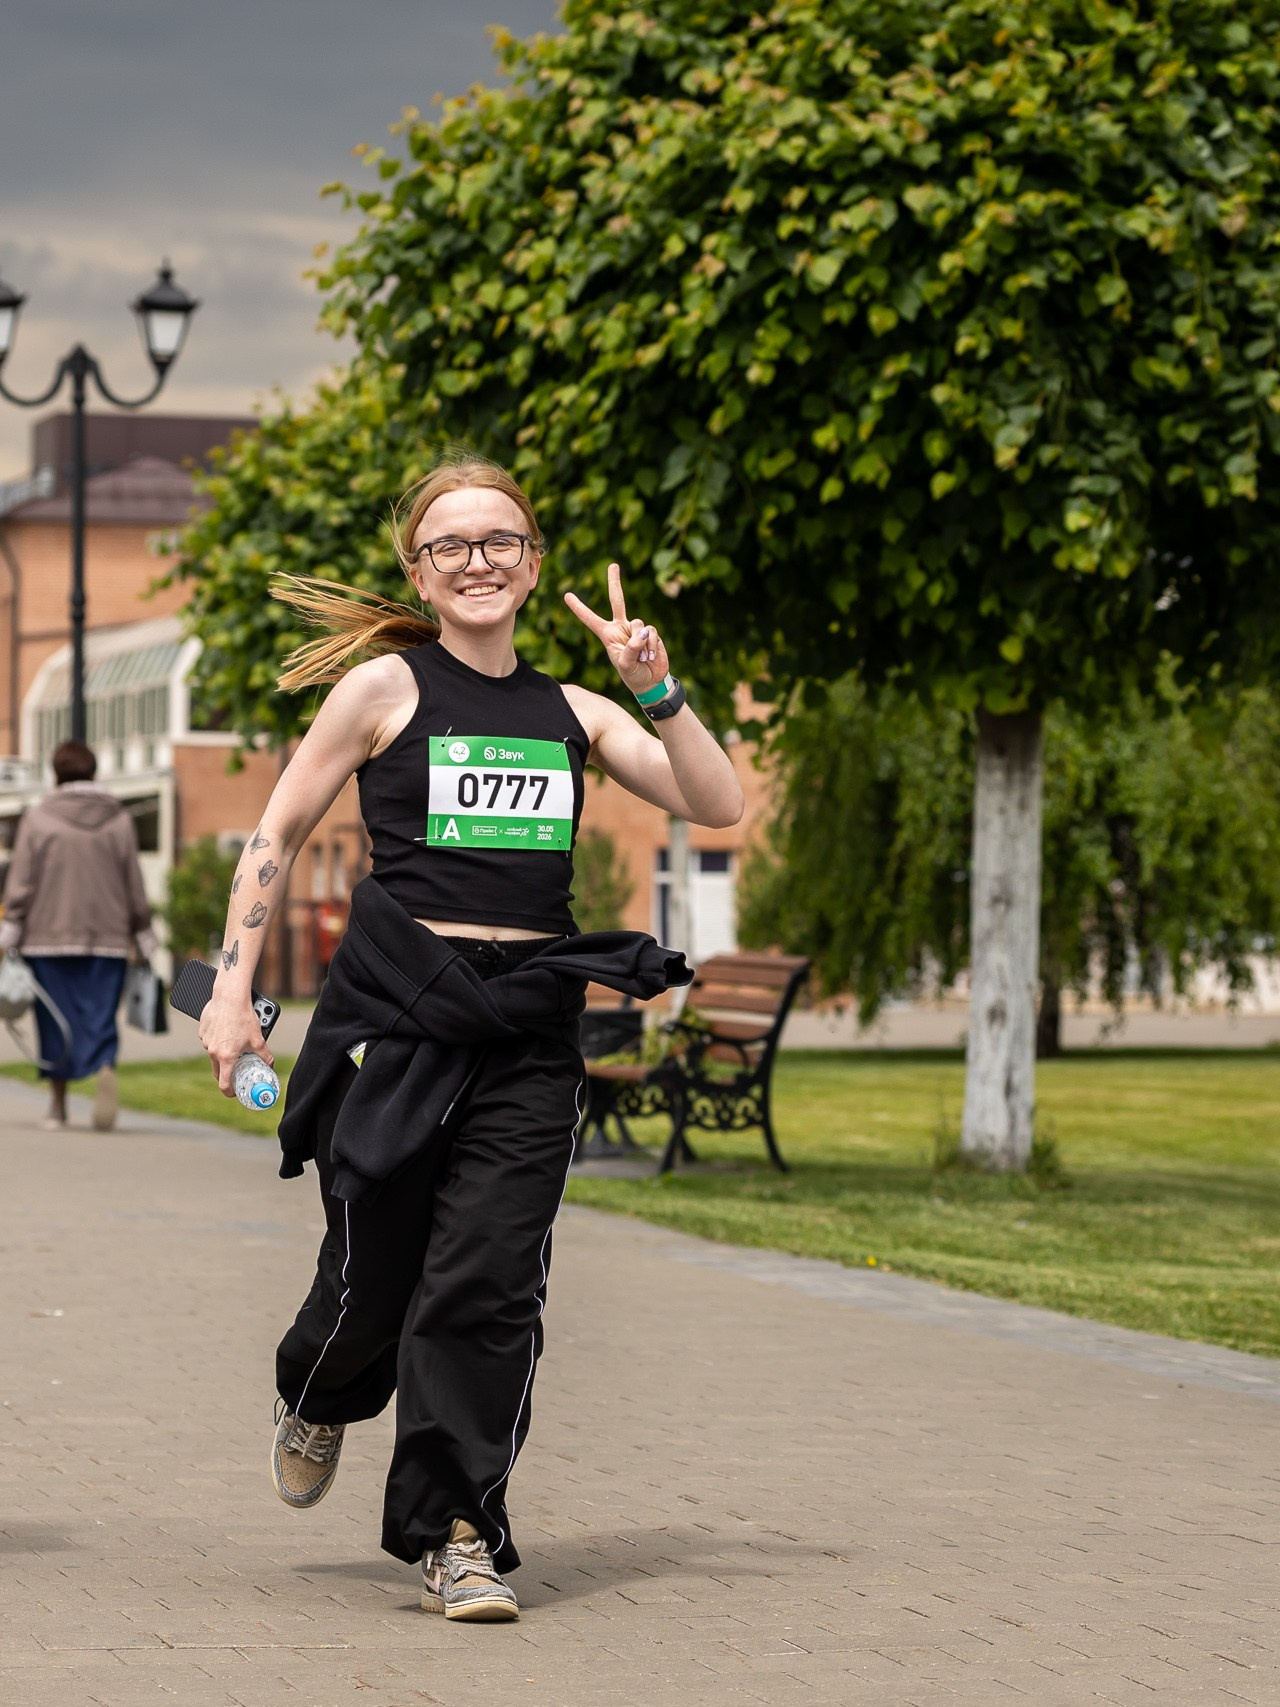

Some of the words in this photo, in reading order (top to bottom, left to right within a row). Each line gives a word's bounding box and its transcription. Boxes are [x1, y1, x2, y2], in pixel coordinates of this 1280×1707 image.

[498, 748, 524, 761] Звук
[457, 772, 549, 810] 0777
[537, 825, 554, 833] 30.05
[537, 833, 552, 841] 2026
